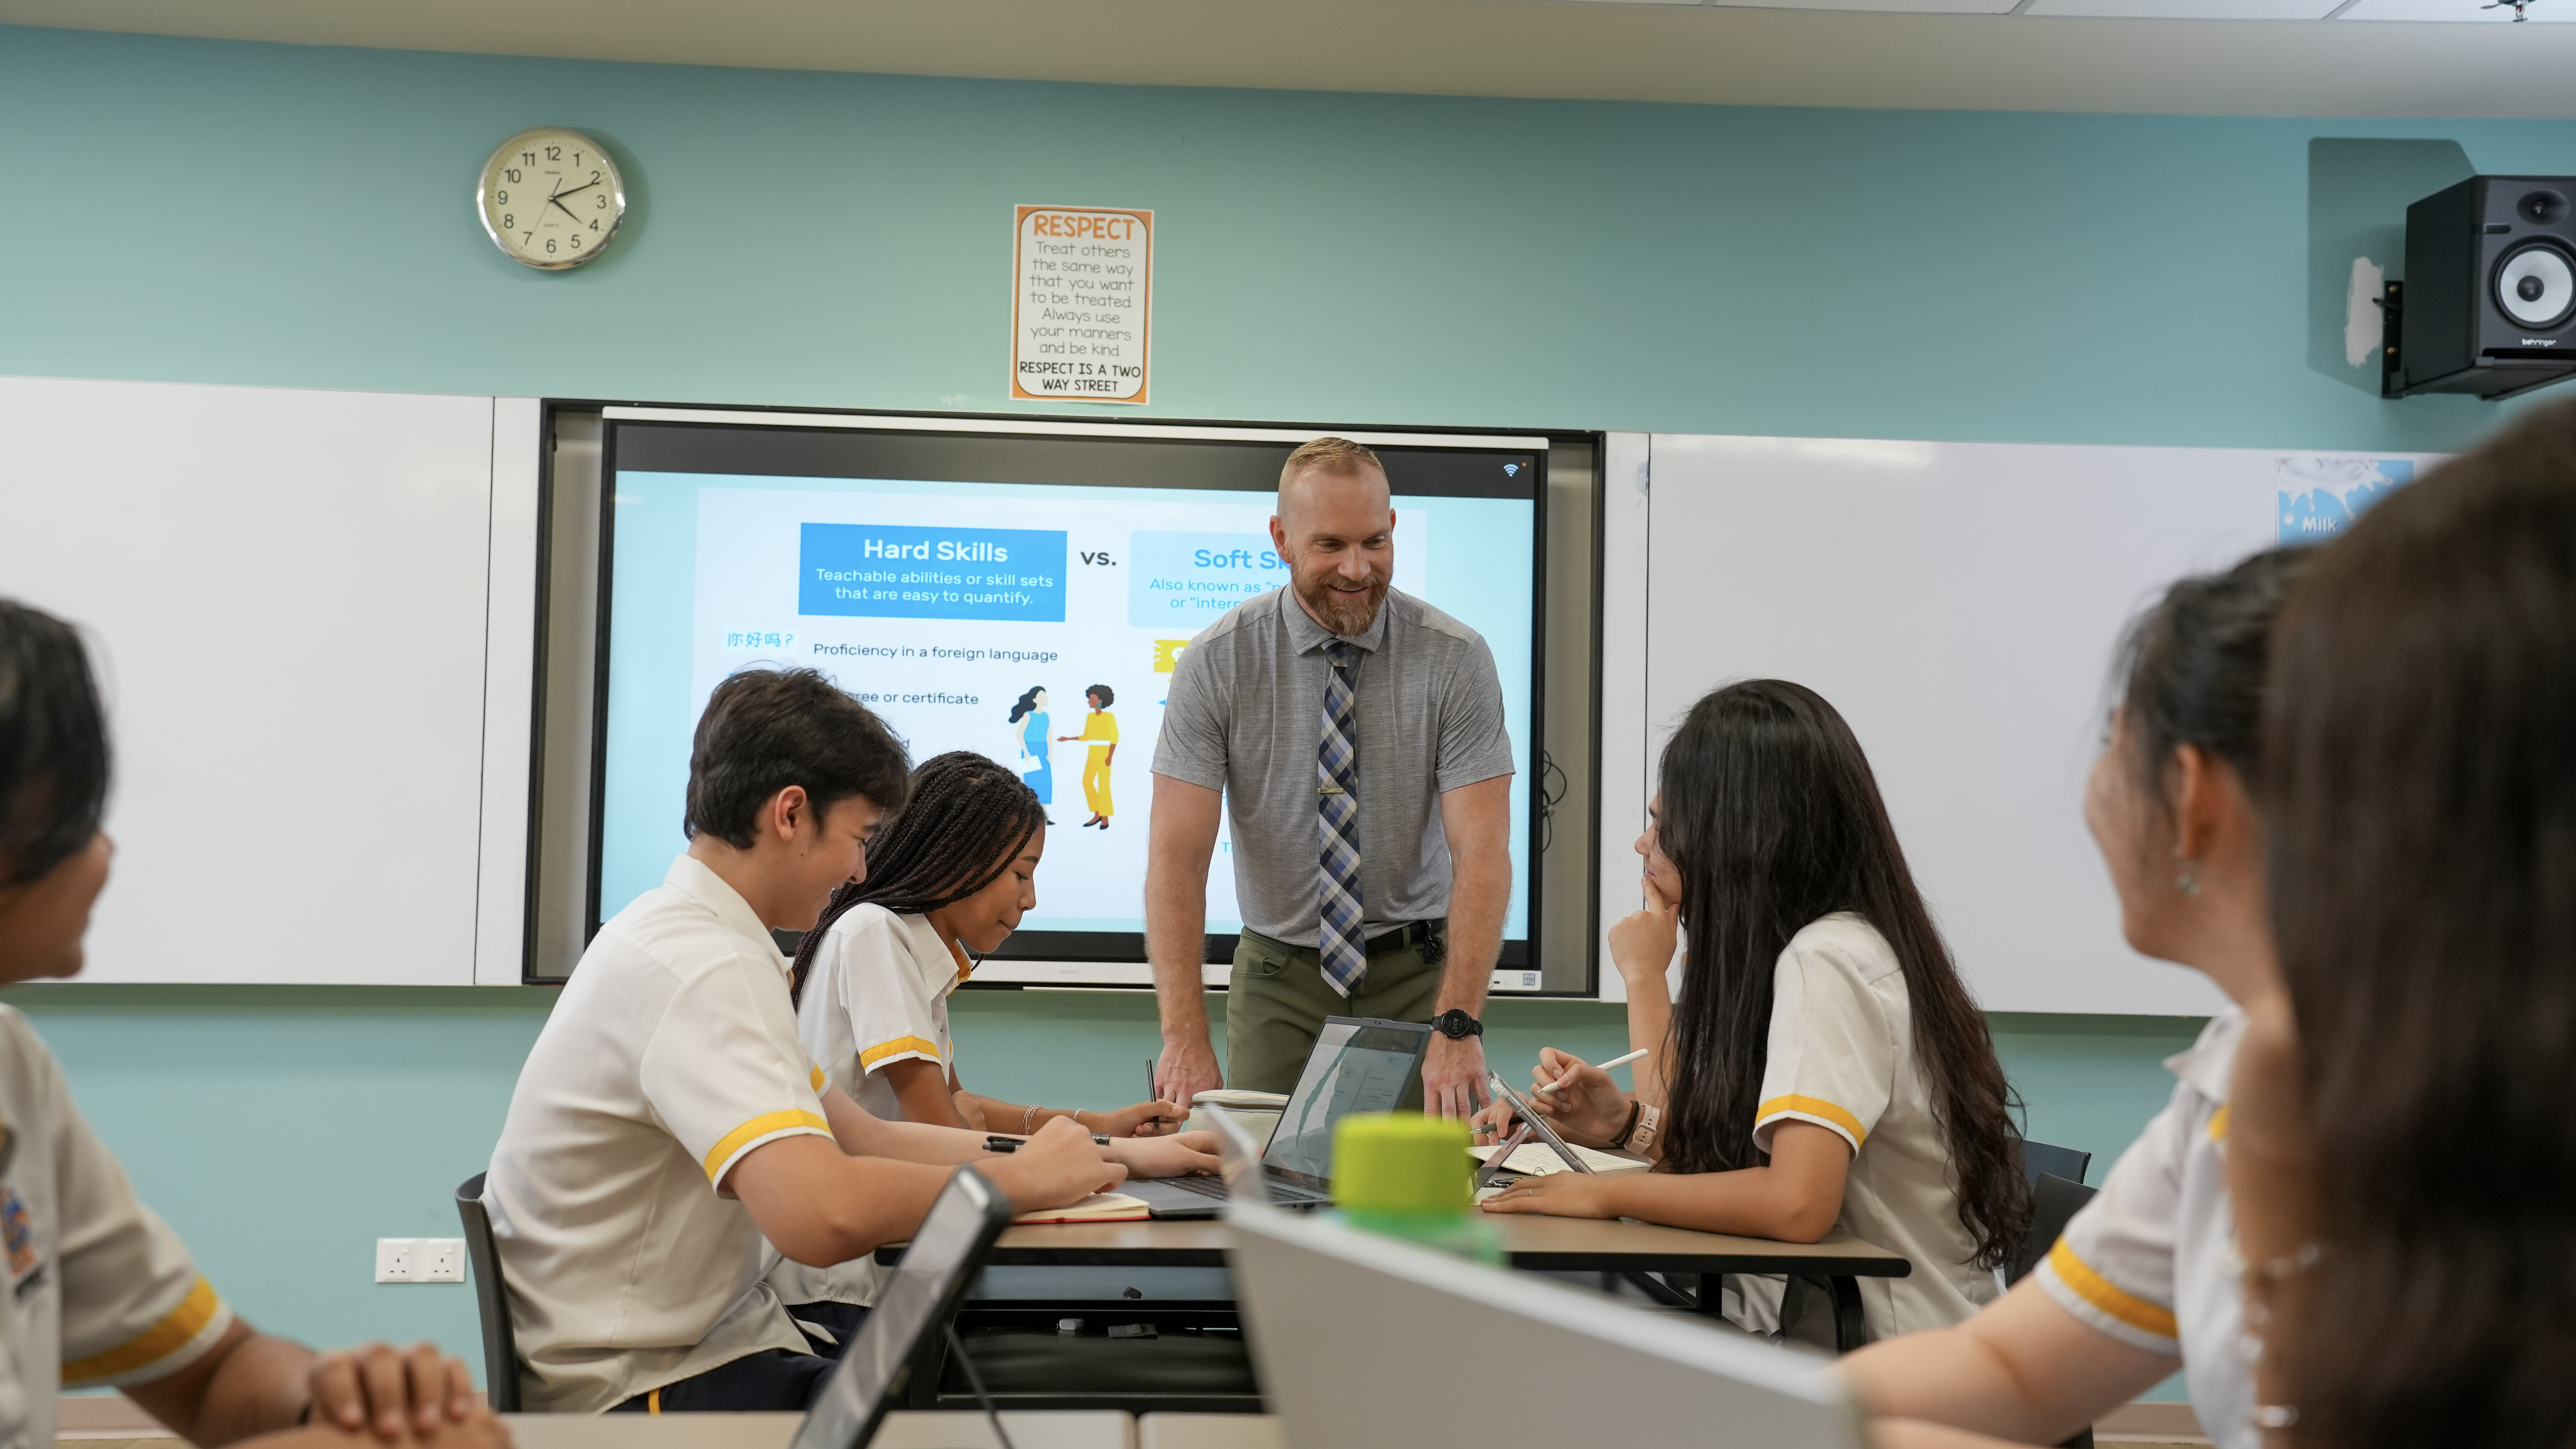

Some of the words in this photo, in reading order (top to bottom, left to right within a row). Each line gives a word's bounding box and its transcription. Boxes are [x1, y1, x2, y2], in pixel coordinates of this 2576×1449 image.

[522, 152, 535, 166] 11
[545, 146, 561, 161] 12
[574, 153, 579, 167] 1
[505, 169, 521, 183] 10
[591, 171, 600, 184] 2
[498, 190, 508, 205] 9
[597, 195, 606, 209] 3
[504, 214, 514, 229] 8
[589, 219, 598, 232] 4
[1034, 215, 1135, 240] RESPECT
[523, 232, 532, 245] 7
[571, 235, 580, 248] 5
[546, 239, 556, 253] 6
[1036, 241, 1076, 255] Treat
[1081, 244, 1130, 258] others
[1032, 258, 1056, 271] the
[1062, 262, 1101, 273] same
[1106, 265, 1133, 278] way
[1029, 274, 1063, 287] that
[1068, 279, 1094, 291] you
[1099, 279, 1135, 291] want
[1030, 291, 1046, 303] to
[1052, 291, 1069, 304] be
[1042, 308, 1090, 324] Always
[1096, 314, 1120, 323] use
[1030, 327, 1064, 339] your
[1069, 329, 1131, 341] manners
[1040, 342, 1065, 354] and
[1070, 342, 1087, 354] be
[2522, 338, 2557, 347] behringer
[1020, 362, 1074, 374] RESPECT
[1079, 364, 1092, 375] IS
[1098, 365, 1106, 375] A
[1112, 365, 1141, 378] TWO
[1043, 379, 1069, 390] WAY
[1075, 380, 1118, 391] STREET
[2303, 516, 2337, 533] Milk
[865, 539, 929, 559] Hard
[937, 541, 1008, 562] Skills
[1194, 549, 1252, 569] Soft
[816, 569, 896, 582] Teachable
[901, 571, 961, 584] abilities
[966, 576, 982, 585] or
[987, 574, 1015, 586] skill
[1020, 575, 1053, 587] sets
[1150, 579, 1183, 590] Also
[1188, 580, 1238, 591] known
[1244, 584, 1260, 593] as
[835, 587, 868, 599] that
[873, 590, 898, 600] are
[902, 591, 939, 604] easy
[943, 590, 959, 602] to
[963, 591, 1033, 606] quantify.
[1171, 600, 1186, 608] or
[815, 644, 897, 658] Proficiency
[902, 646, 914, 656] in
[932, 647, 984, 661] foreign
[990, 649, 1057, 663] language
[903, 693, 978, 704] certificate
